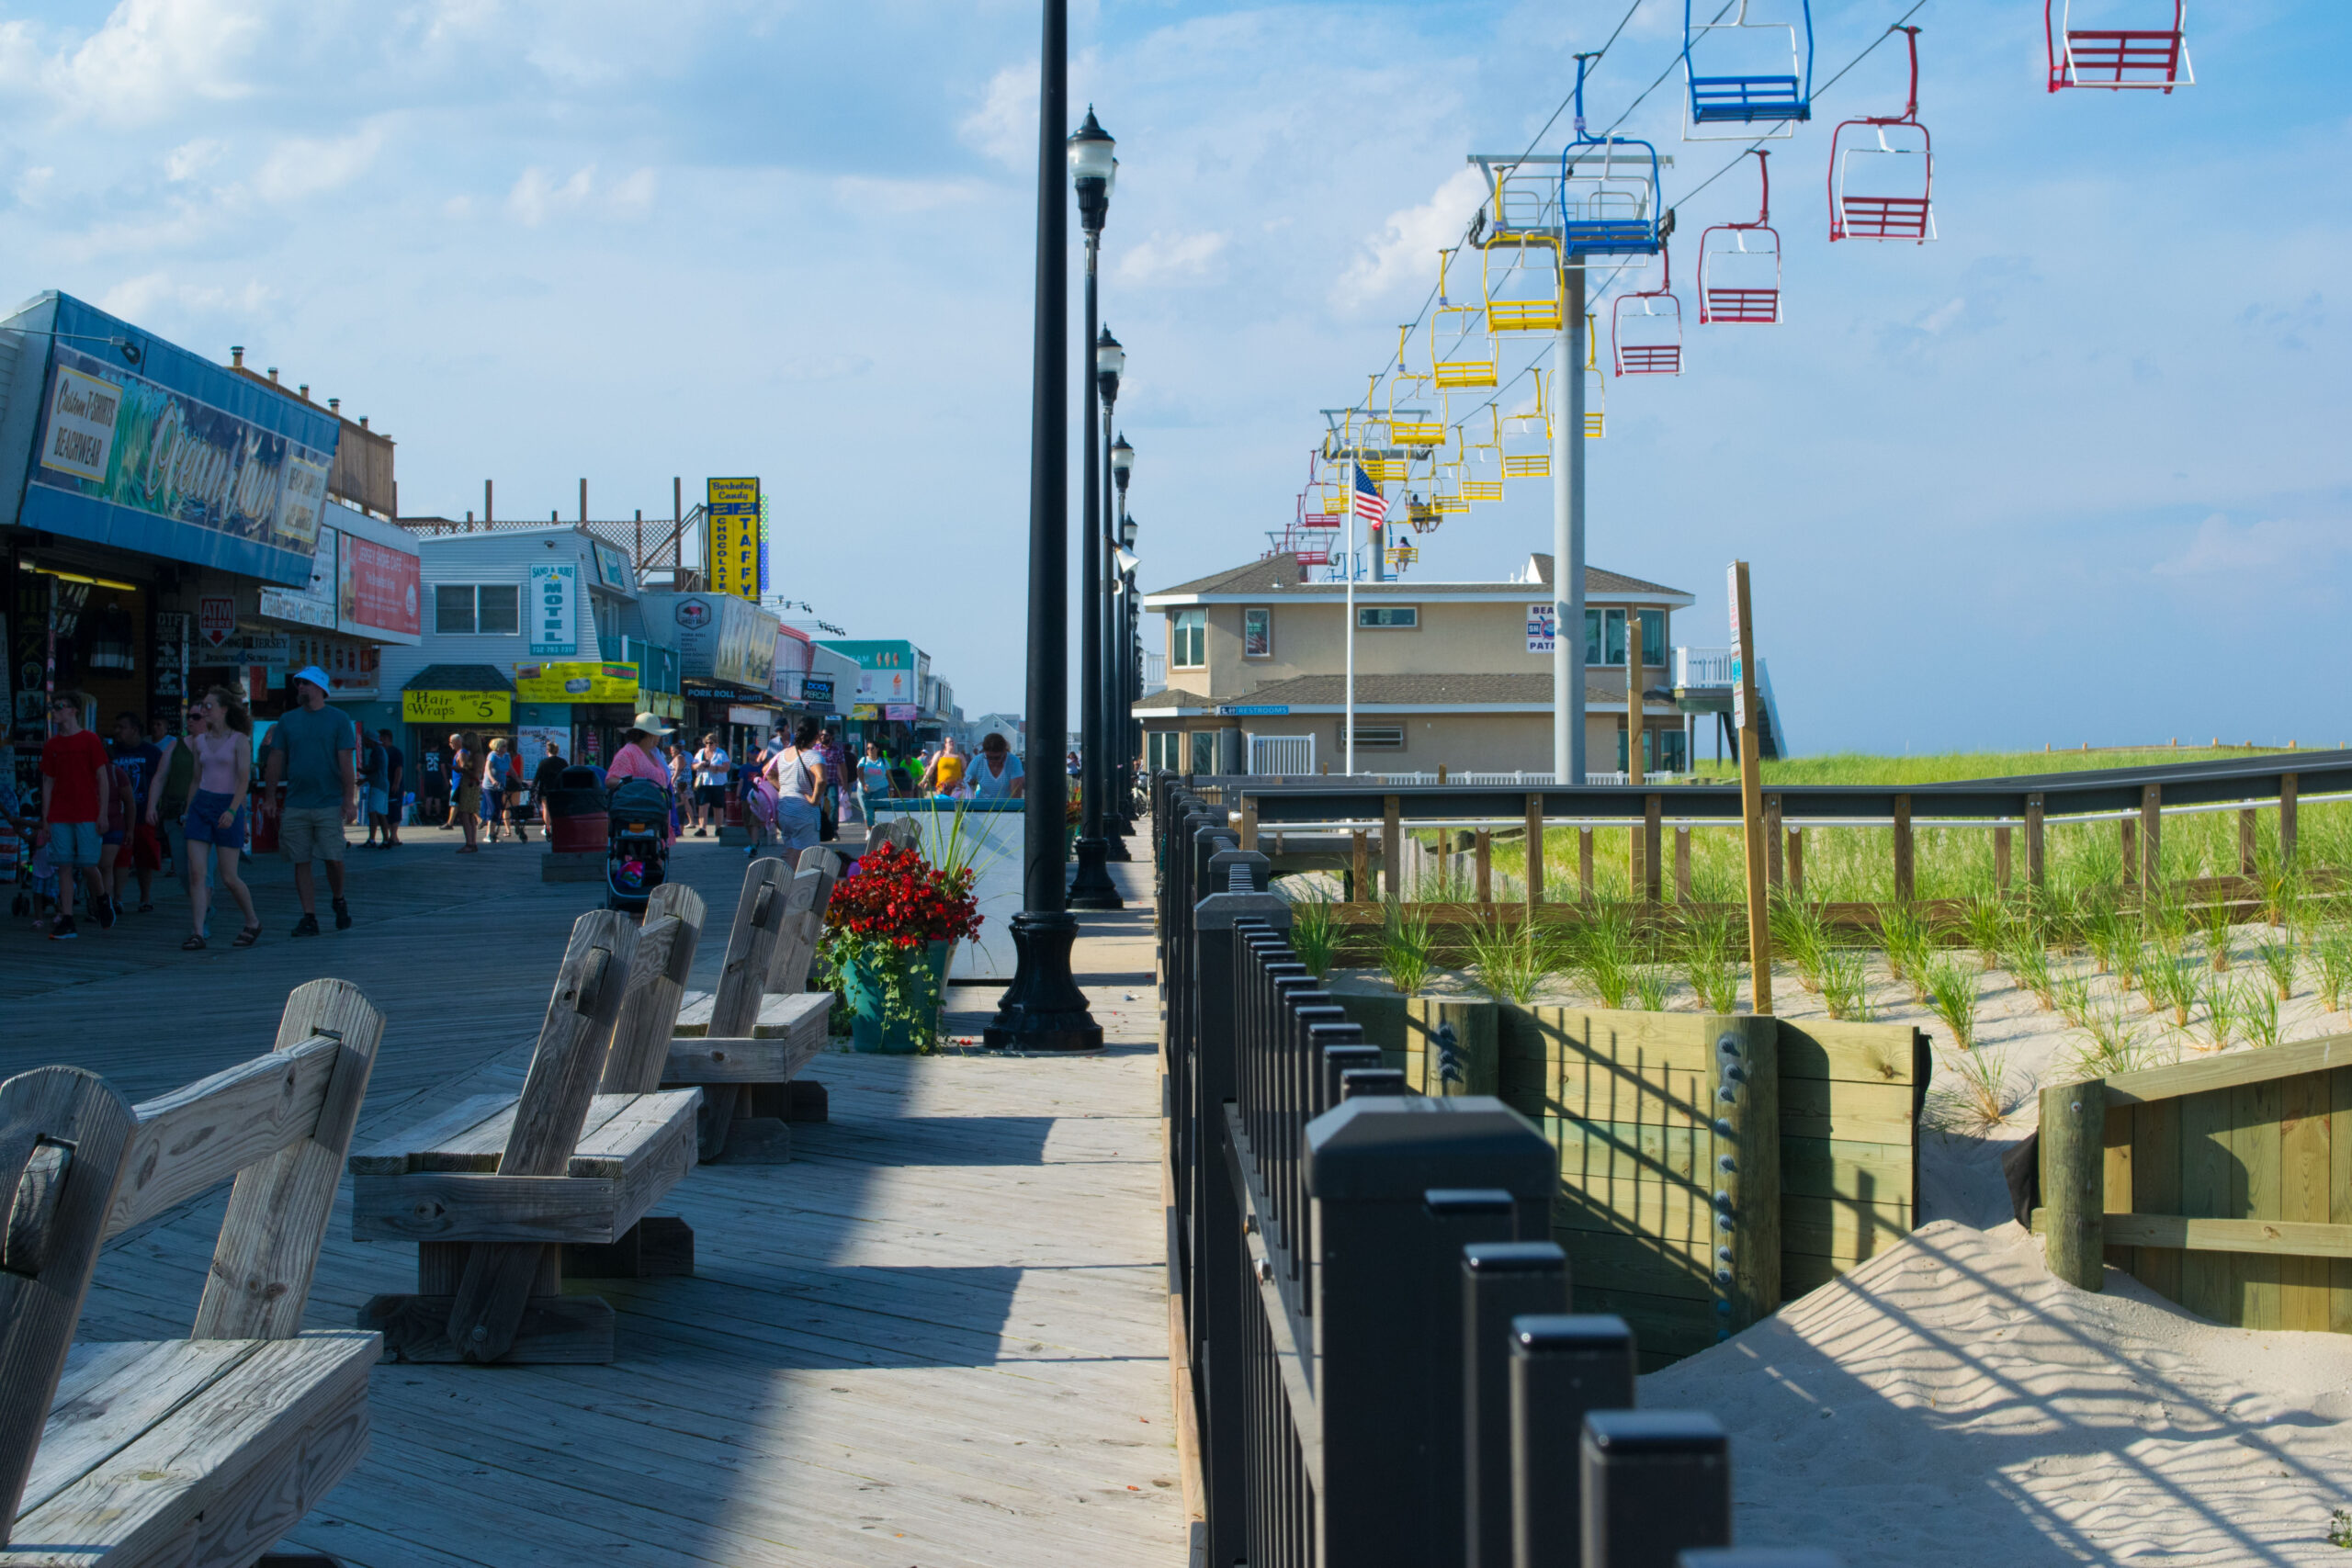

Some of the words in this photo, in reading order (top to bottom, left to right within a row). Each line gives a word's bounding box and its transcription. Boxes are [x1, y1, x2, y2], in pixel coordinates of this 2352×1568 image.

[57, 378, 86, 418] Custom
[85, 390, 116, 427] T-SHIRTS
[53, 426, 103, 468] BEACHWEAR
[145, 400, 228, 508] Ocean
[718, 491, 749, 501] Candy
[739, 517, 752, 595] TAFFY
[532, 567, 548, 578] SAND
[558, 567, 573, 578] SURF
[203, 601, 232, 620] ATM
[544, 583, 562, 641] MOTEL
[1532, 606, 1554, 615] BEA
[203, 620, 233, 628] HERE
[1528, 625, 1539, 633] SH
[253, 637, 288, 649] JERSEY
[687, 689, 712, 698] PORK
[714, 690, 735, 698] ROLL
[808, 682, 831, 694] body
[412, 691, 452, 705] Hair
[738, 694, 763, 702] ONUTS
[803, 691, 831, 702] PIERCING
[407, 703, 455, 720] Wraps
